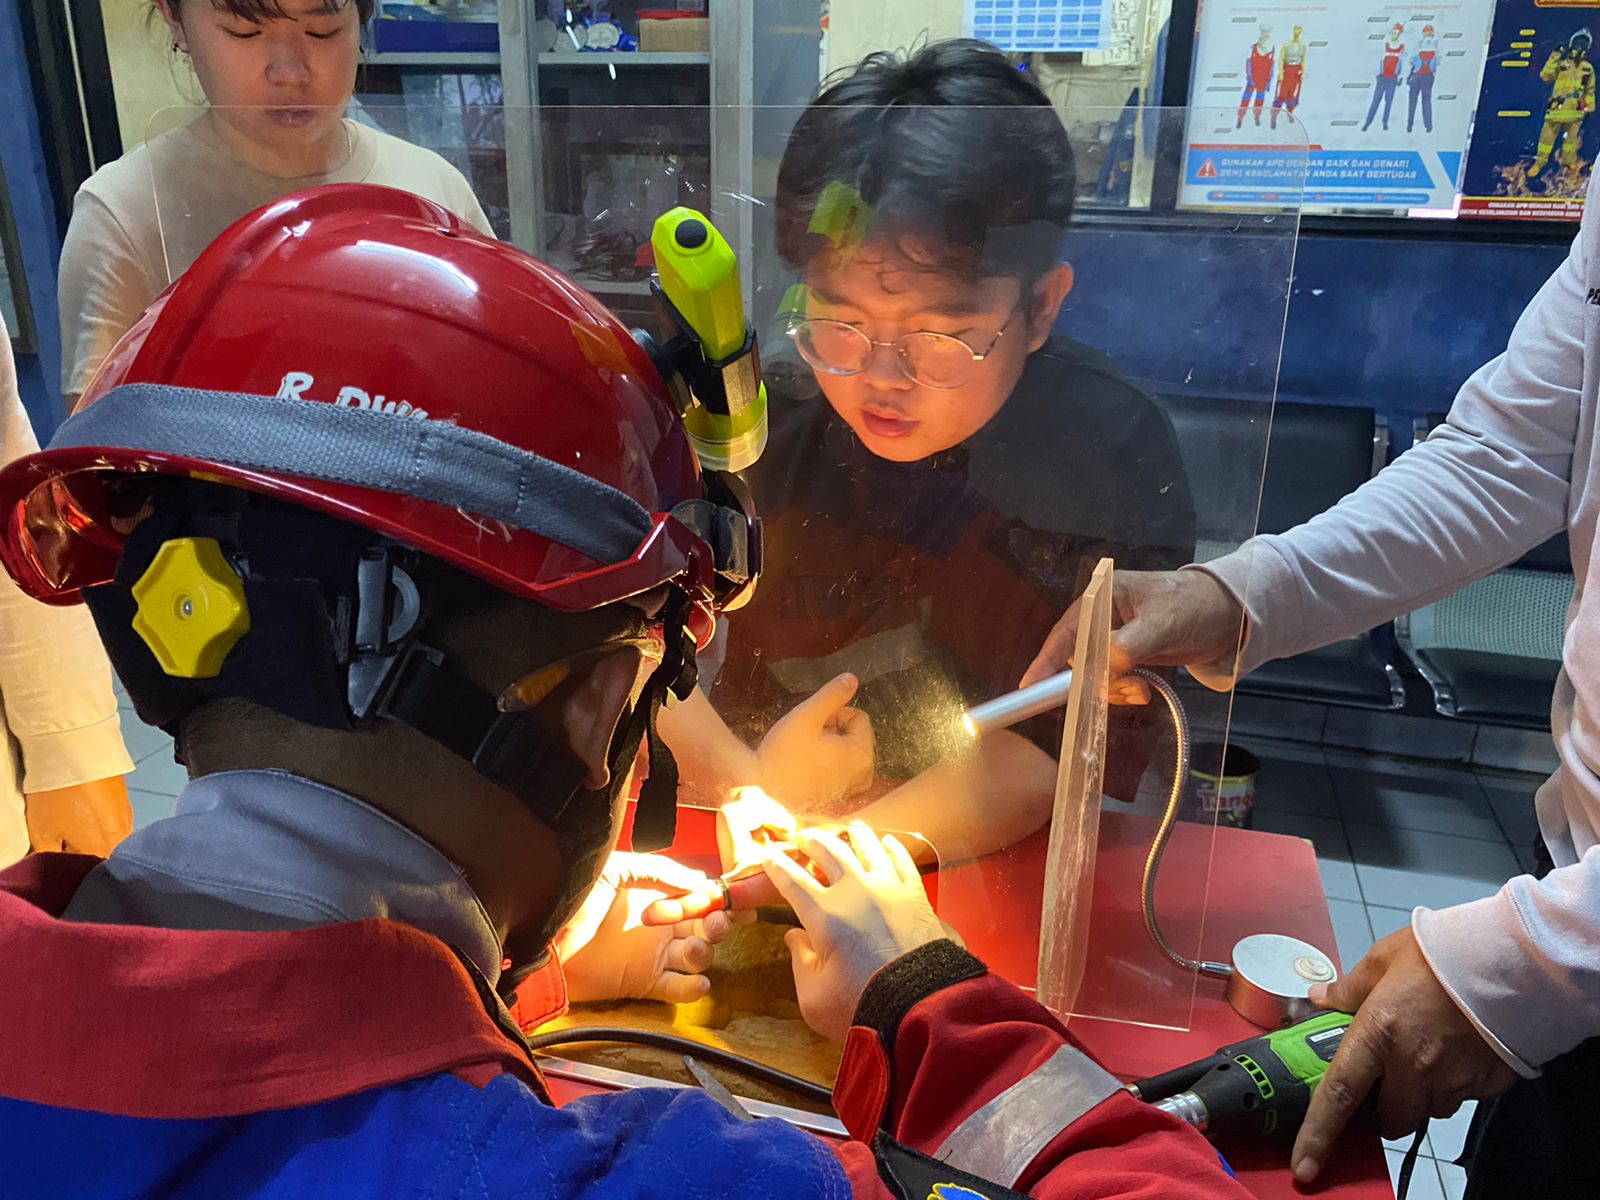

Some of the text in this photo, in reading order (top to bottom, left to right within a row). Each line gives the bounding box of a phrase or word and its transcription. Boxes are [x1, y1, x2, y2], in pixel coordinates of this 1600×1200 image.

[1221, 158, 1265, 167] GUNAKAN
[1266, 159, 1285, 167] APD
[1325, 159, 1350, 167] BAIK
[1351, 159, 1371, 167] DAN
[1220, 169, 1243, 177] DEMI
[1340, 170, 1365, 178] SAAT
[1366, 171, 1417, 179] BERTUGAS
[1585, 287, 1600, 306] PE
